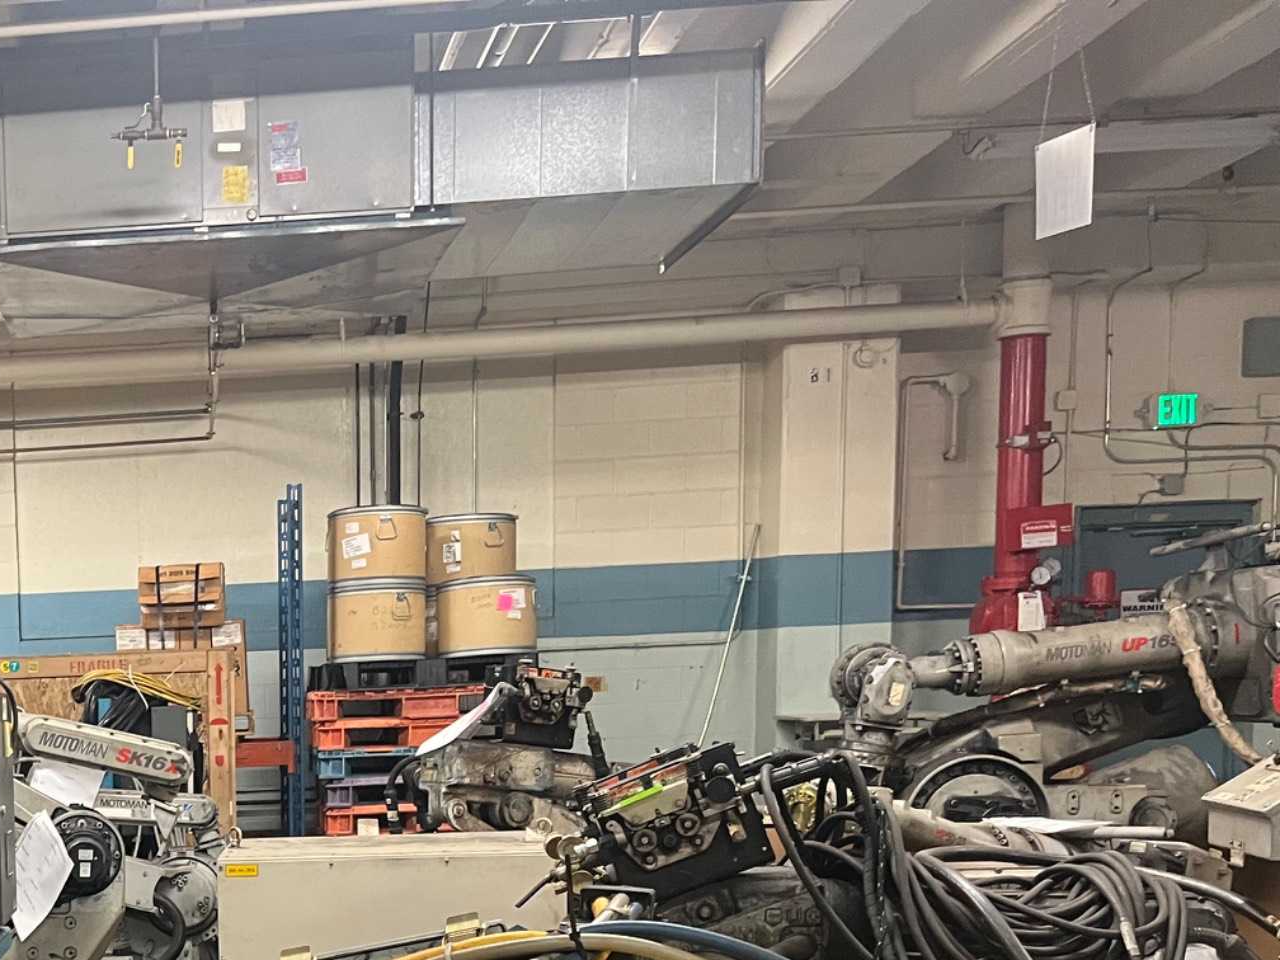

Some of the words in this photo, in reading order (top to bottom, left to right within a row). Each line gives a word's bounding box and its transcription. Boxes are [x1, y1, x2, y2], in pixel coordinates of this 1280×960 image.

[1158, 395, 1197, 425] EXIT
[1122, 604, 1164, 613] WARNI
[38, 731, 110, 760] MOTOMAN
[100, 799, 148, 809] MOTOMAN
